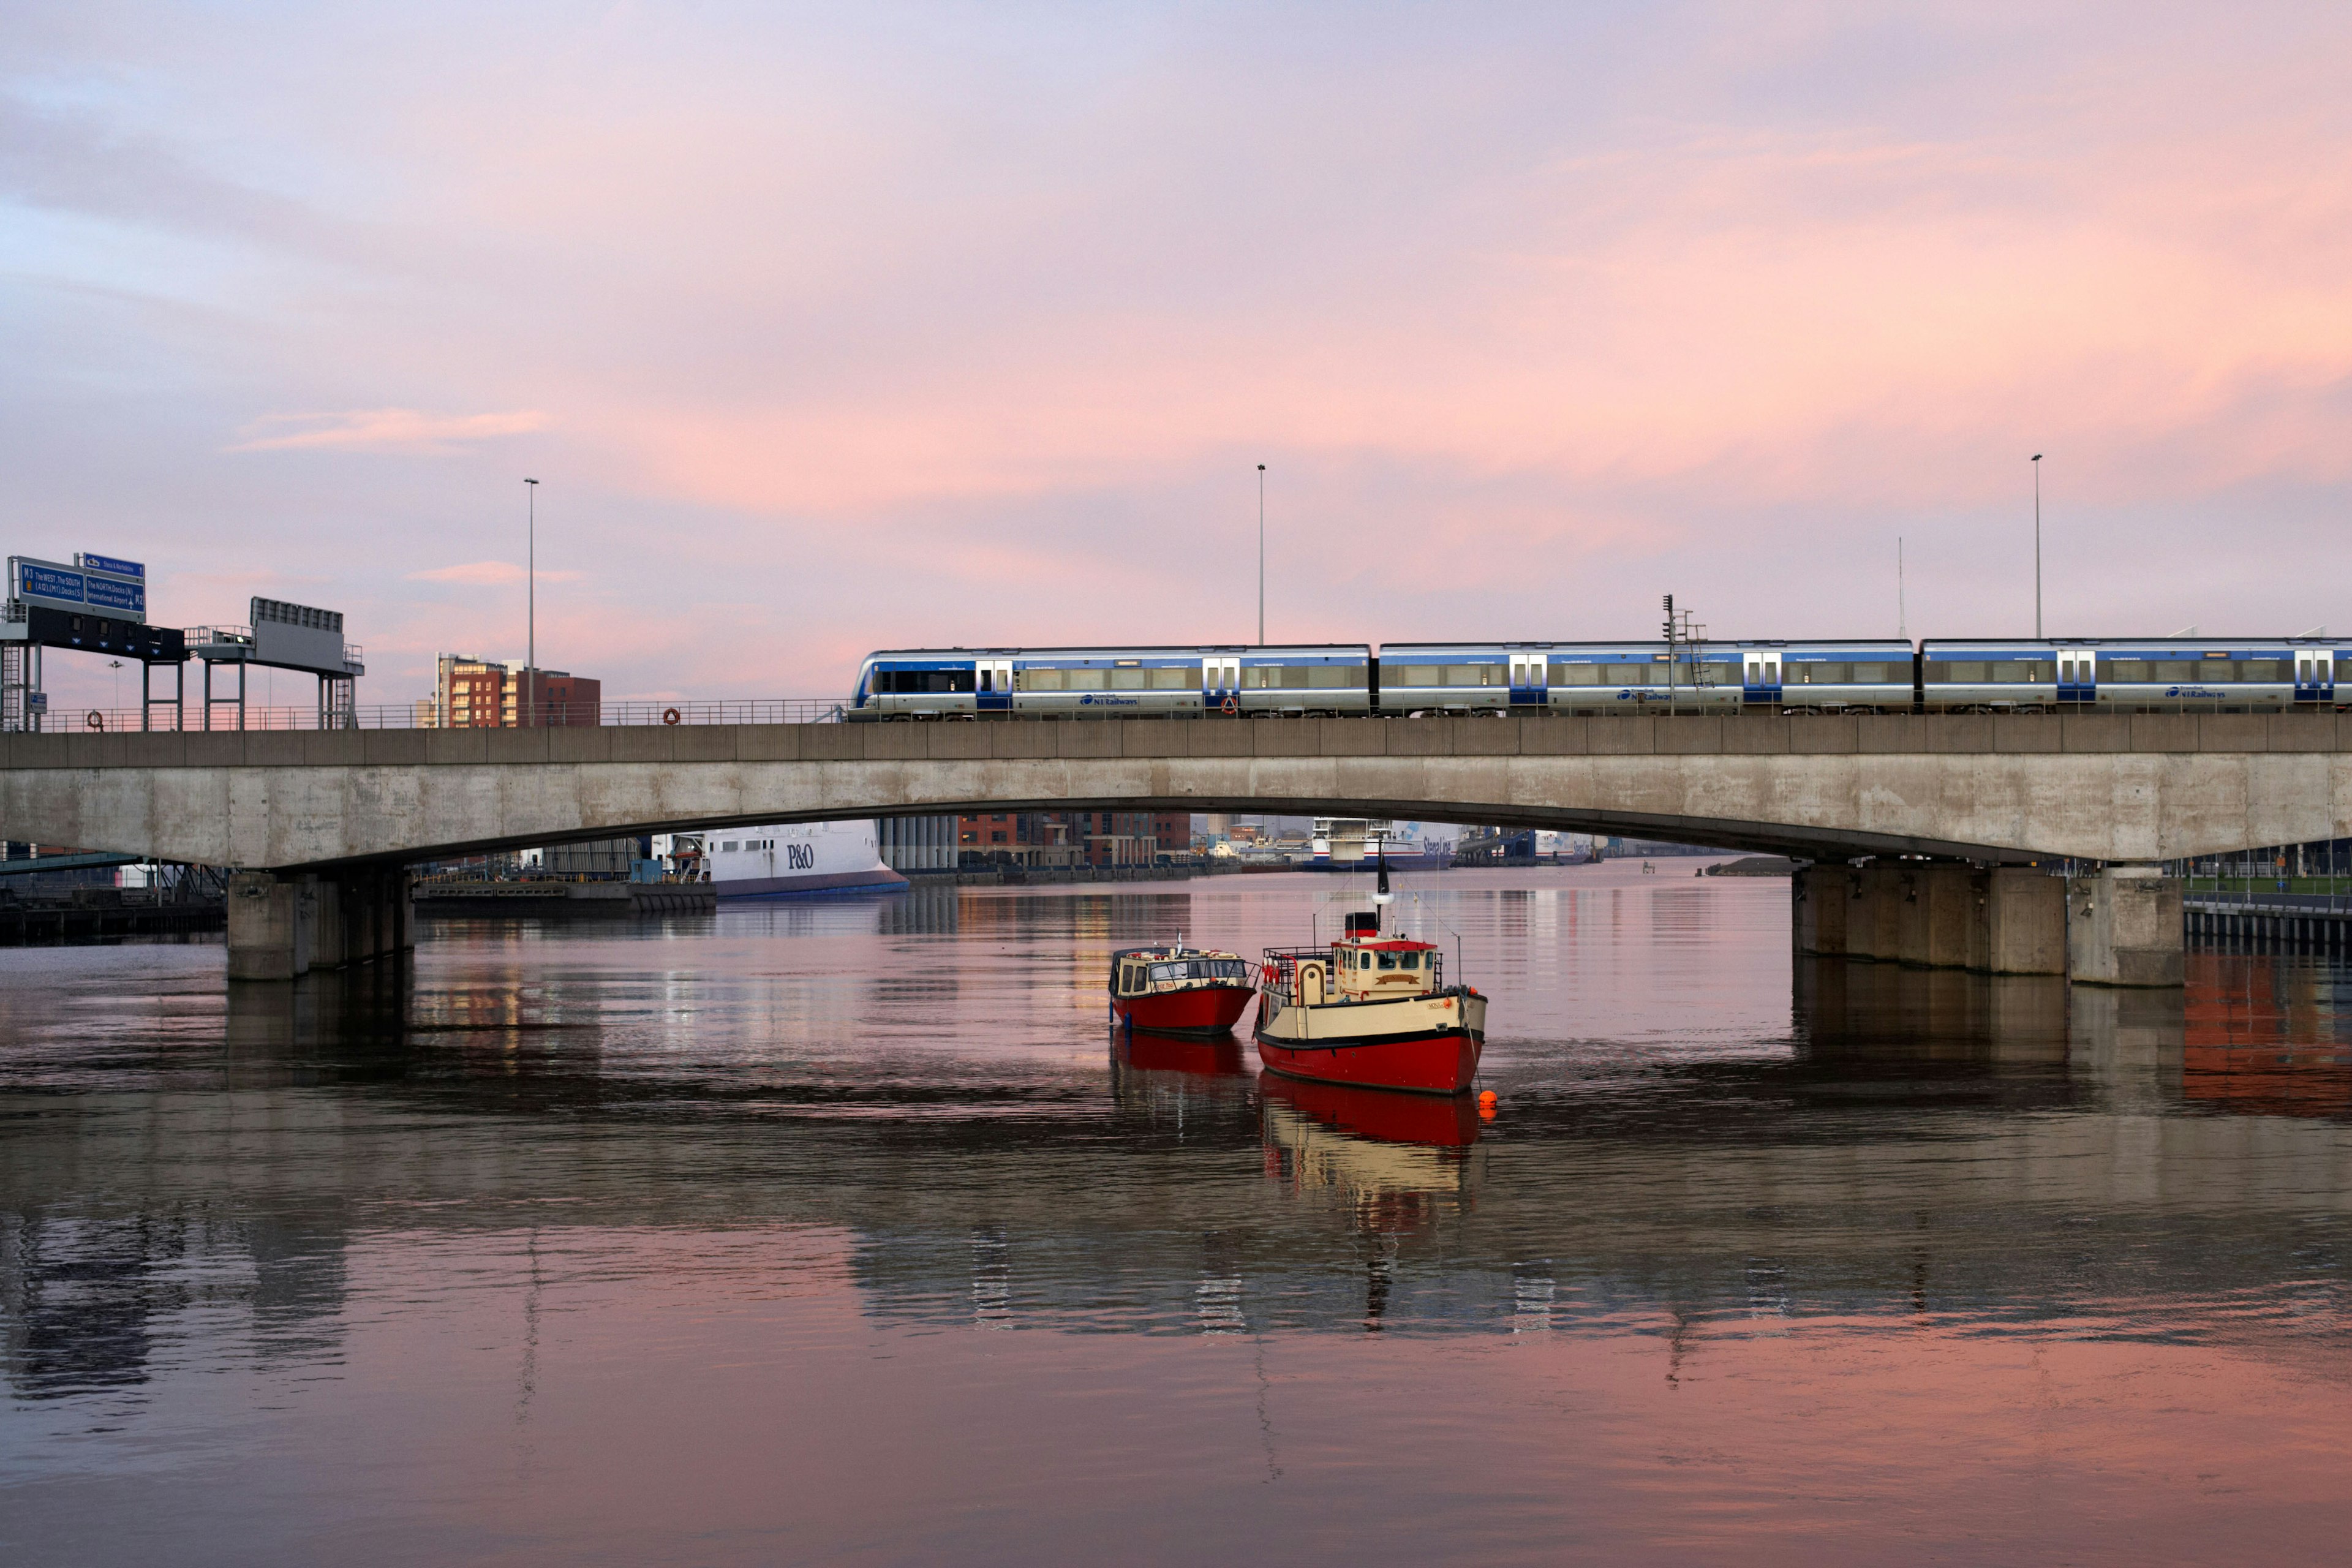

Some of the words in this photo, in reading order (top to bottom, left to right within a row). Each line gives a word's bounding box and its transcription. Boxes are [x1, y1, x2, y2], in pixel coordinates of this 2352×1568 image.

[66, 578, 80, 587] SOUTH
[88, 591, 113, 603] International
[113, 596, 128, 605] Airport
[2191, 690, 2225, 699] Railways
[1106, 698, 1137, 706] Railways
[1424, 835, 1439, 856] Stena
[1439, 835, 1451, 856] Line
[786, 843, 814, 869] P&O
